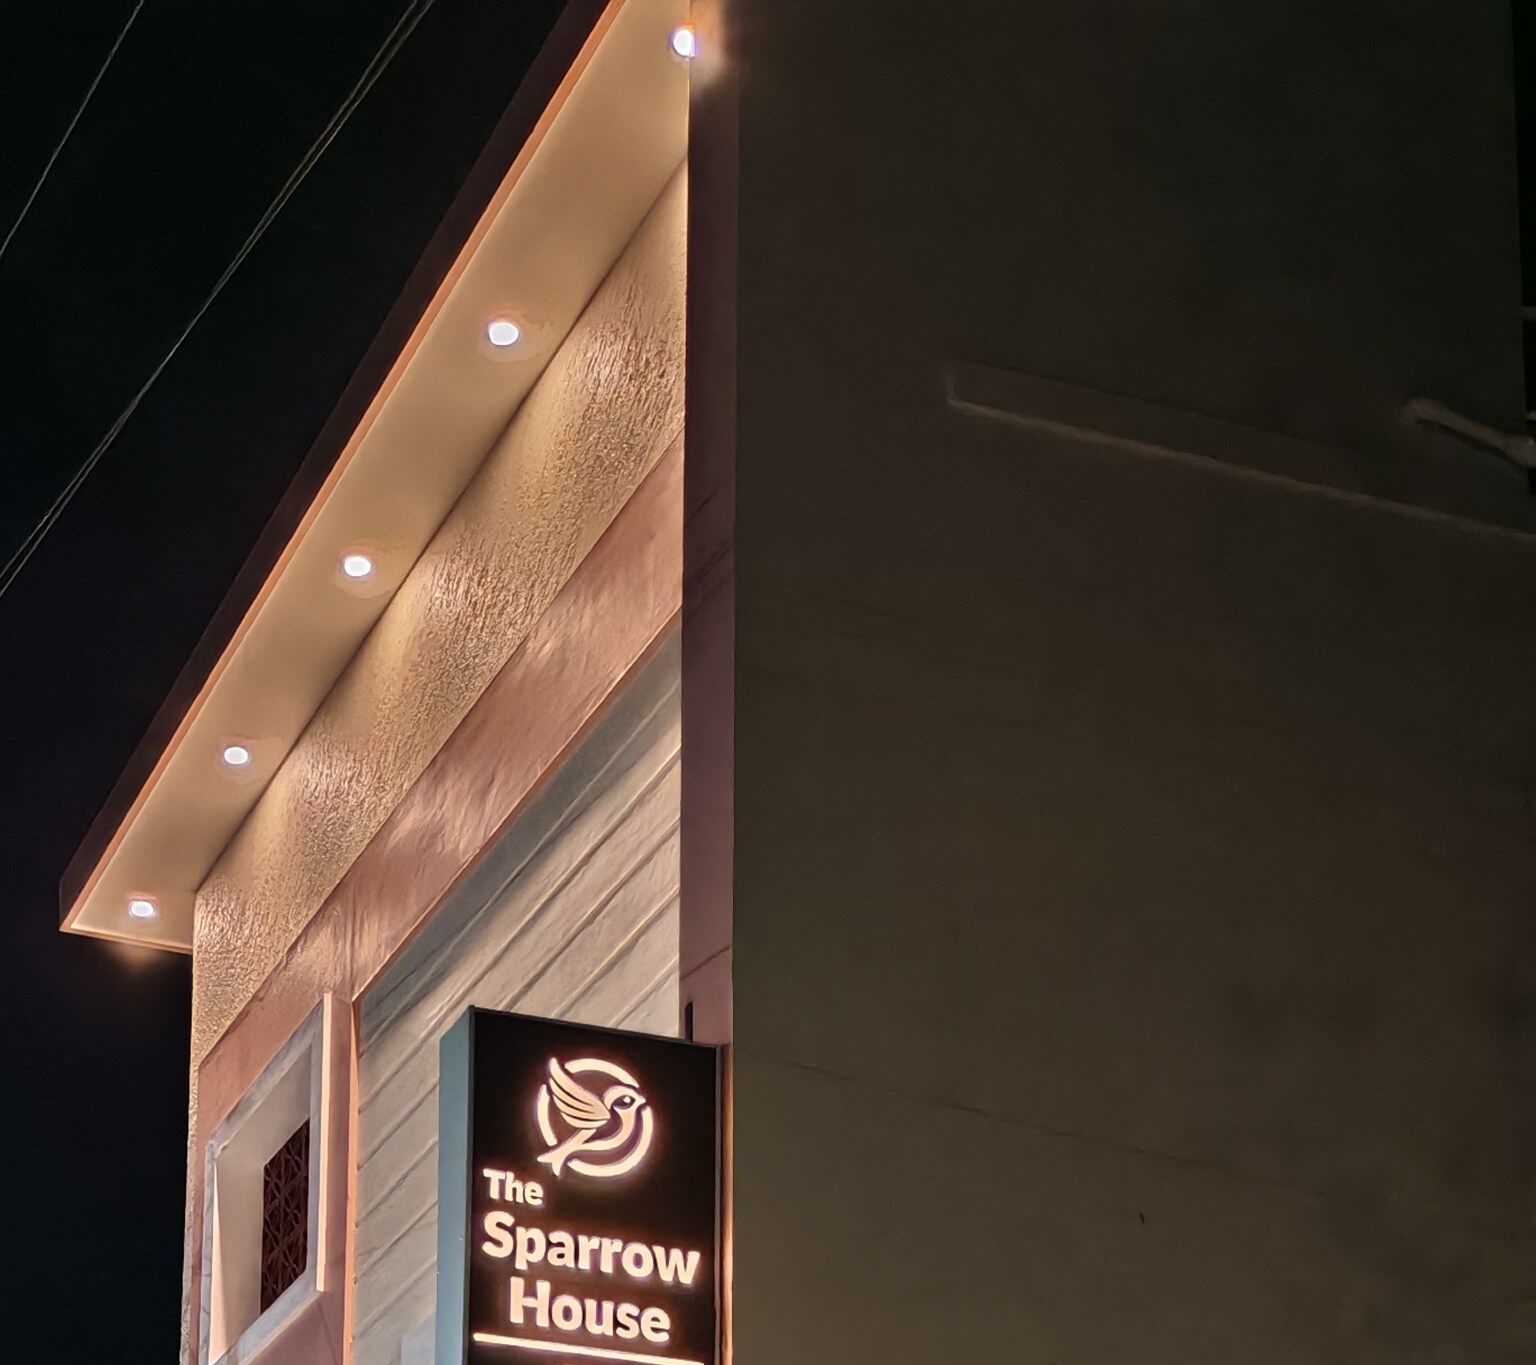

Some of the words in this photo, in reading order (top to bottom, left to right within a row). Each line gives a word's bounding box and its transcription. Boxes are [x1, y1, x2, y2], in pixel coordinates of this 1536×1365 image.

[482, 1168, 543, 1205] The
[482, 1211, 700, 1284] Sparrow
[509, 1276, 671, 1342] House
